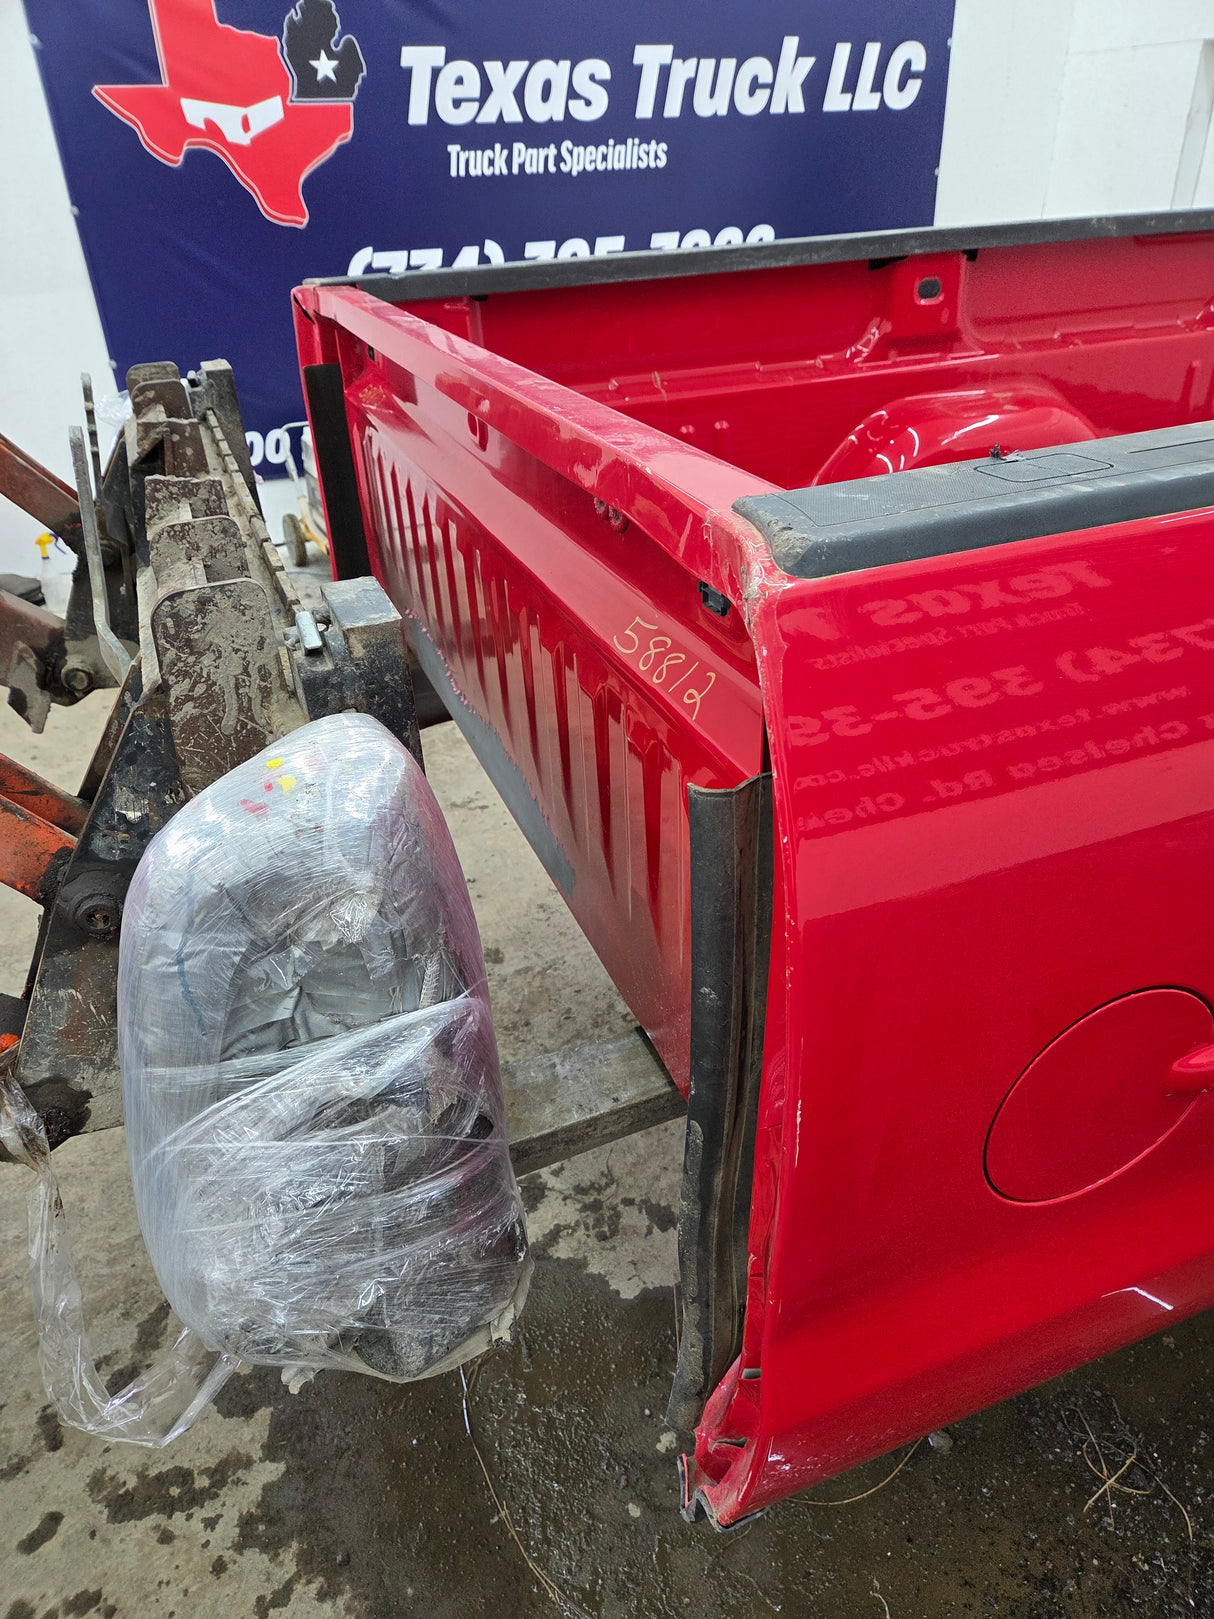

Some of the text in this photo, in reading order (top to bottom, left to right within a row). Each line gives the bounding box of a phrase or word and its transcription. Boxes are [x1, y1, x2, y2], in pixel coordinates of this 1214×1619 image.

[400, 35, 927, 127] Texas Truck LLC
[447, 138, 668, 177] Truck Part Specialists
[613, 616, 716, 721] 58812
